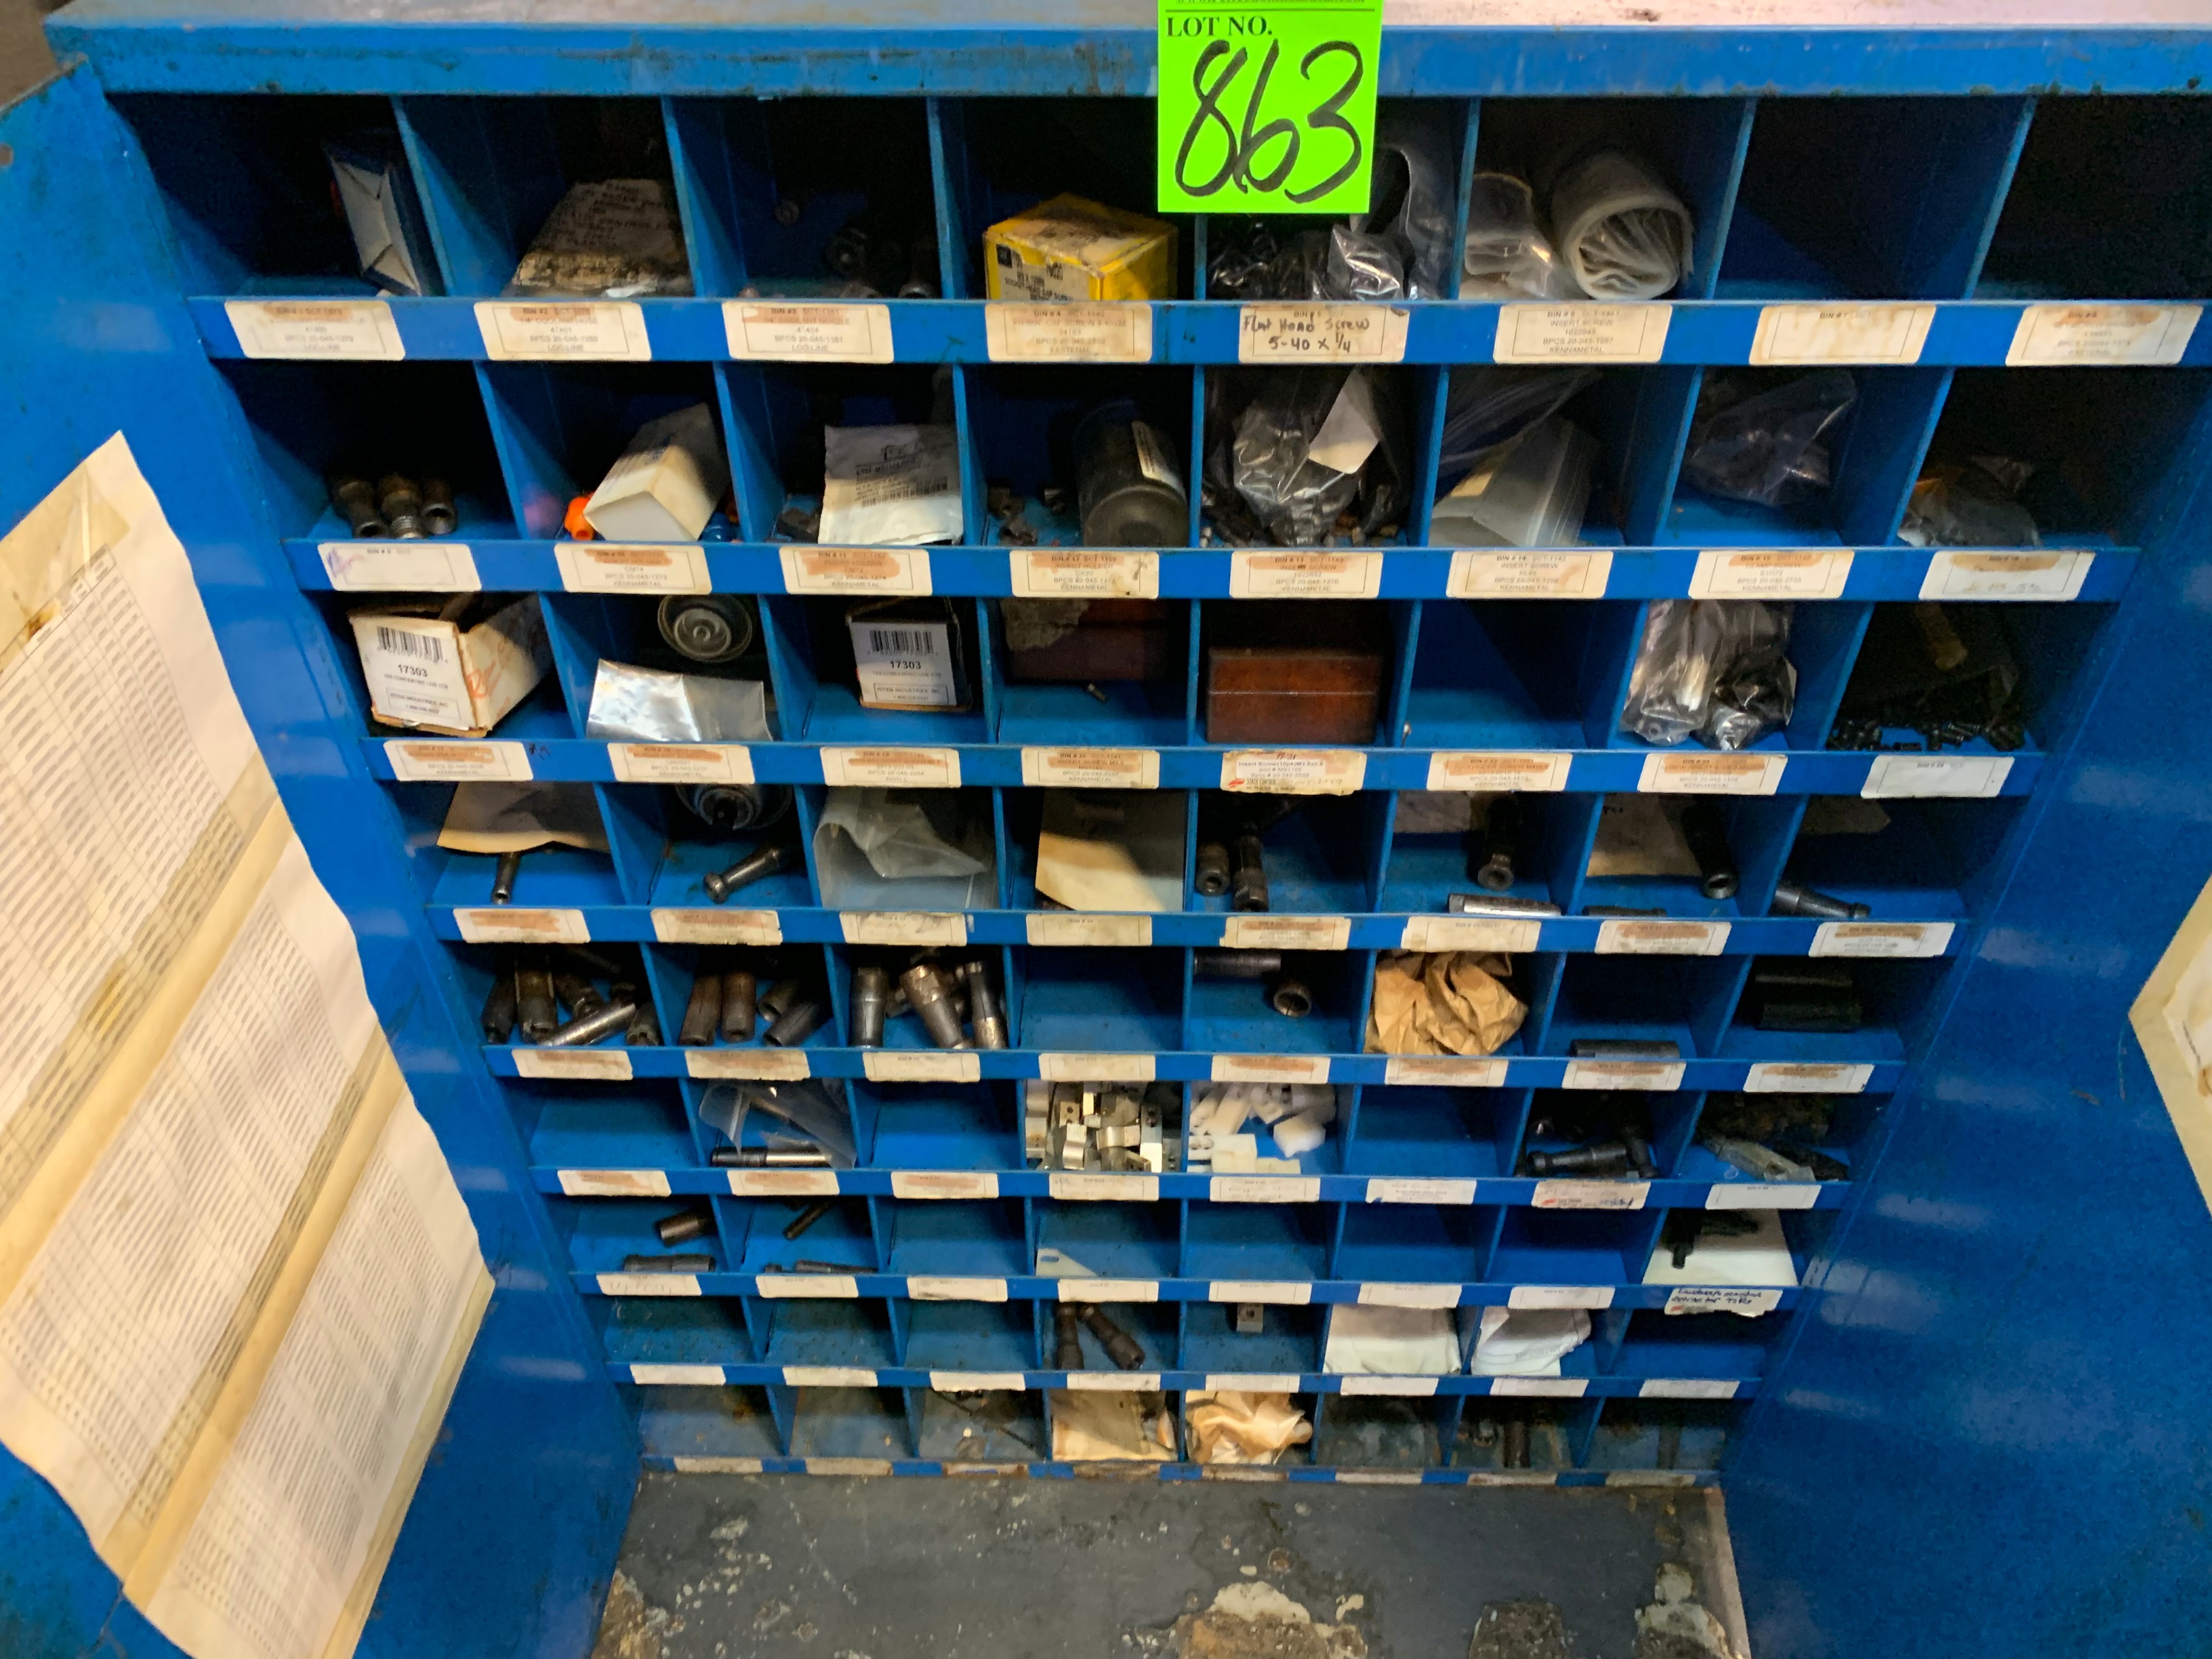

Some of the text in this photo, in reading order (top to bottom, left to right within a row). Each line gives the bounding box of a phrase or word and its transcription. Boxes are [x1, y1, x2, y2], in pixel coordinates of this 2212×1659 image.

[1166, 16, 1273, 37] LOT NO.
[1174, 39, 1364, 204] 863
[1325, 317, 1370, 331] Screw
[1269, 335, 1311, 351] 5-40
[397, 663, 428, 677] 17303
[889, 661, 921, 669] 17303
